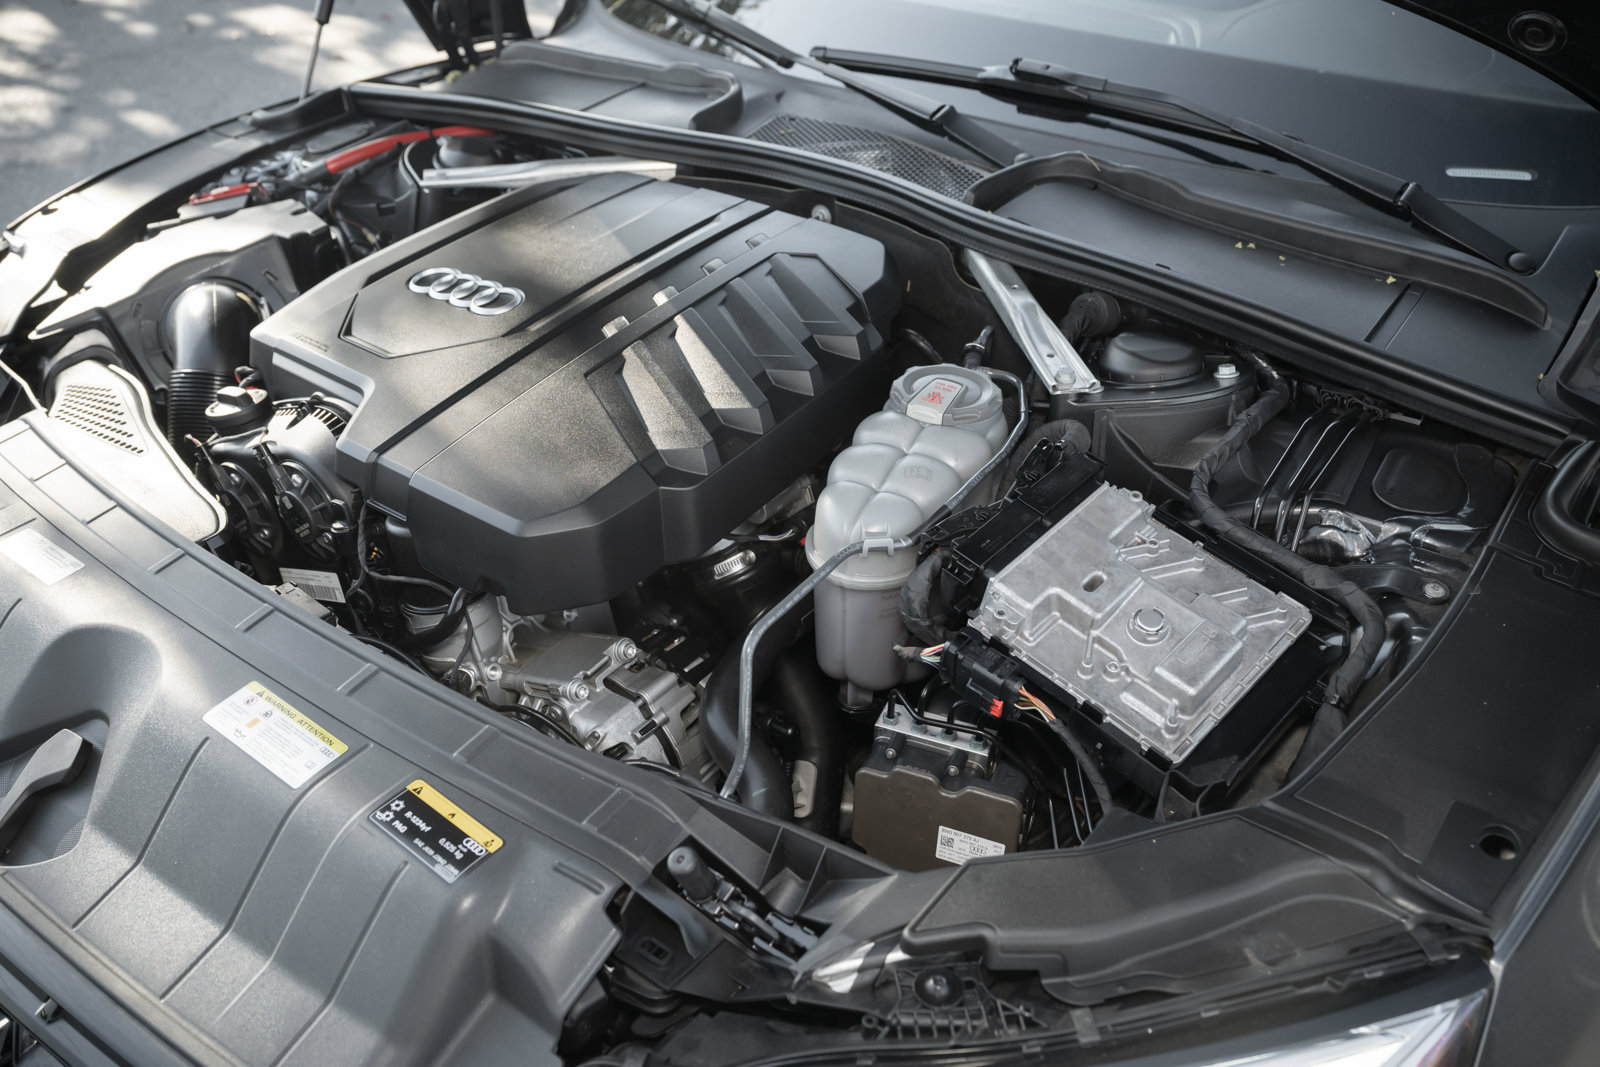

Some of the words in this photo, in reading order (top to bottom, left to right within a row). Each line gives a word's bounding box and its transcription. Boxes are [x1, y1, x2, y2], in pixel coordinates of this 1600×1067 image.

[265, 696, 297, 720] WARNING
[297, 719, 335, 746] ATTENTION
[392, 820, 408, 833] PAG
[404, 811, 432, 832] R-1234yf
